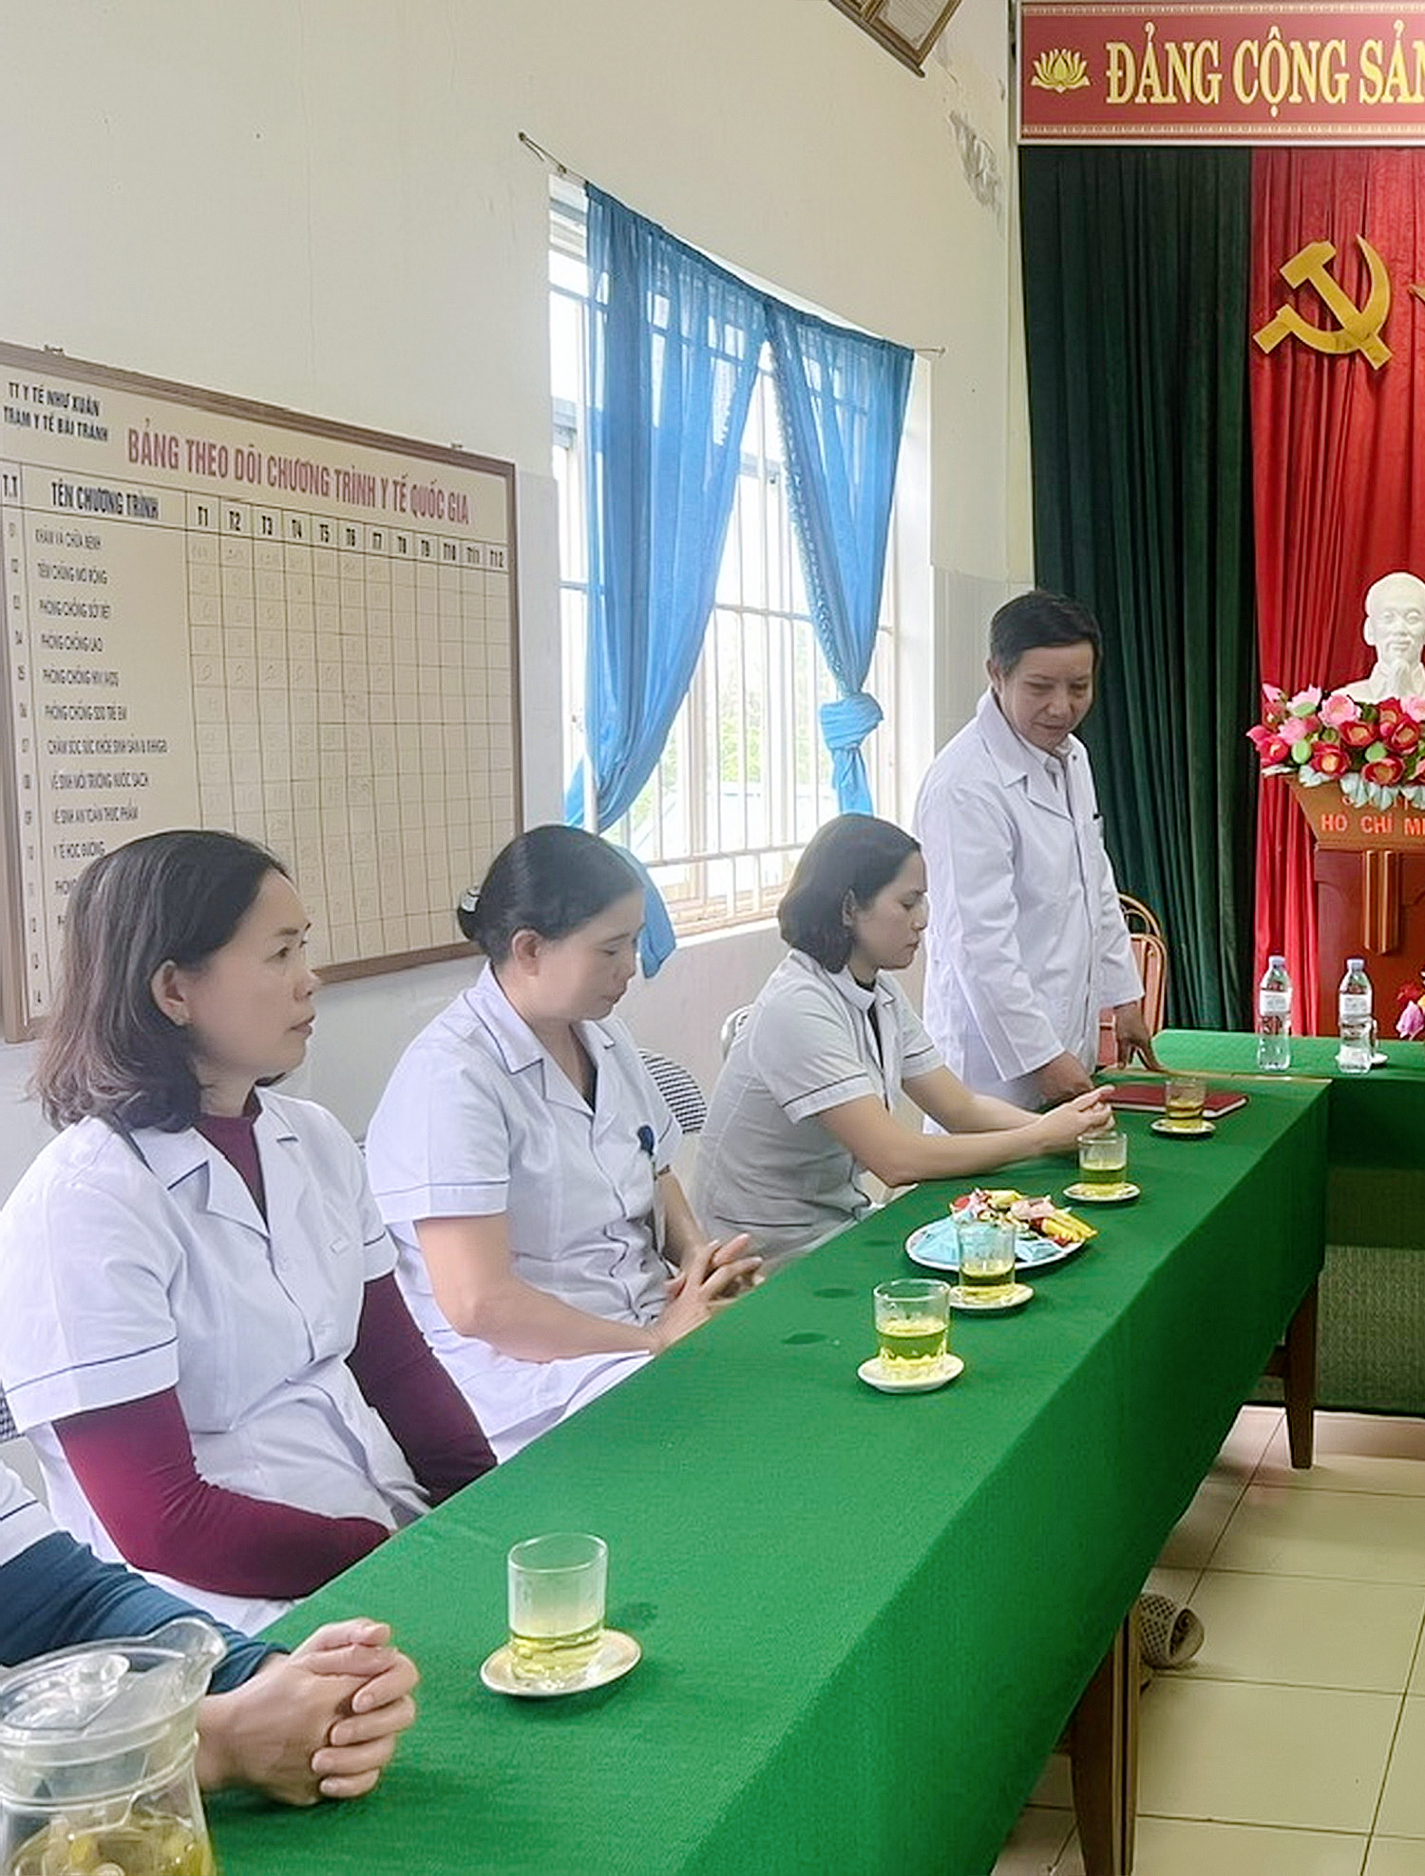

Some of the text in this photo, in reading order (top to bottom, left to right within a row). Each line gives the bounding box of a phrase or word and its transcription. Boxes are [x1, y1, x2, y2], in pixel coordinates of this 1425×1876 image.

[1106, 21, 1221, 104] ĐẢNG
[1232, 26, 1350, 117] CỘNG
[9, 382, 19, 398] TT
[23, 385, 28, 400] Y
[34, 413, 39, 429] Y
[128, 418, 469, 525] BẢNG THEO DÕI CHƯƠNG TRÌNH Y TẾ QUỐC GIA
[51, 478, 74, 507] TÊN
[76, 486, 122, 515] CHƯƠNG
[198, 504, 209, 527] T1
[229, 511, 241, 531] T2
[262, 515, 273, 536] T3
[291, 519, 302, 538] T4
[319, 524, 329, 543] T5
[346, 528, 356, 546] T6
[373, 532, 382, 550] T7
[397, 536, 407, 554] T8
[421, 539, 430, 557] T9
[443, 543, 456, 561] T10
[467, 547, 480, 564] T11
[490, 550, 504, 568] T12
